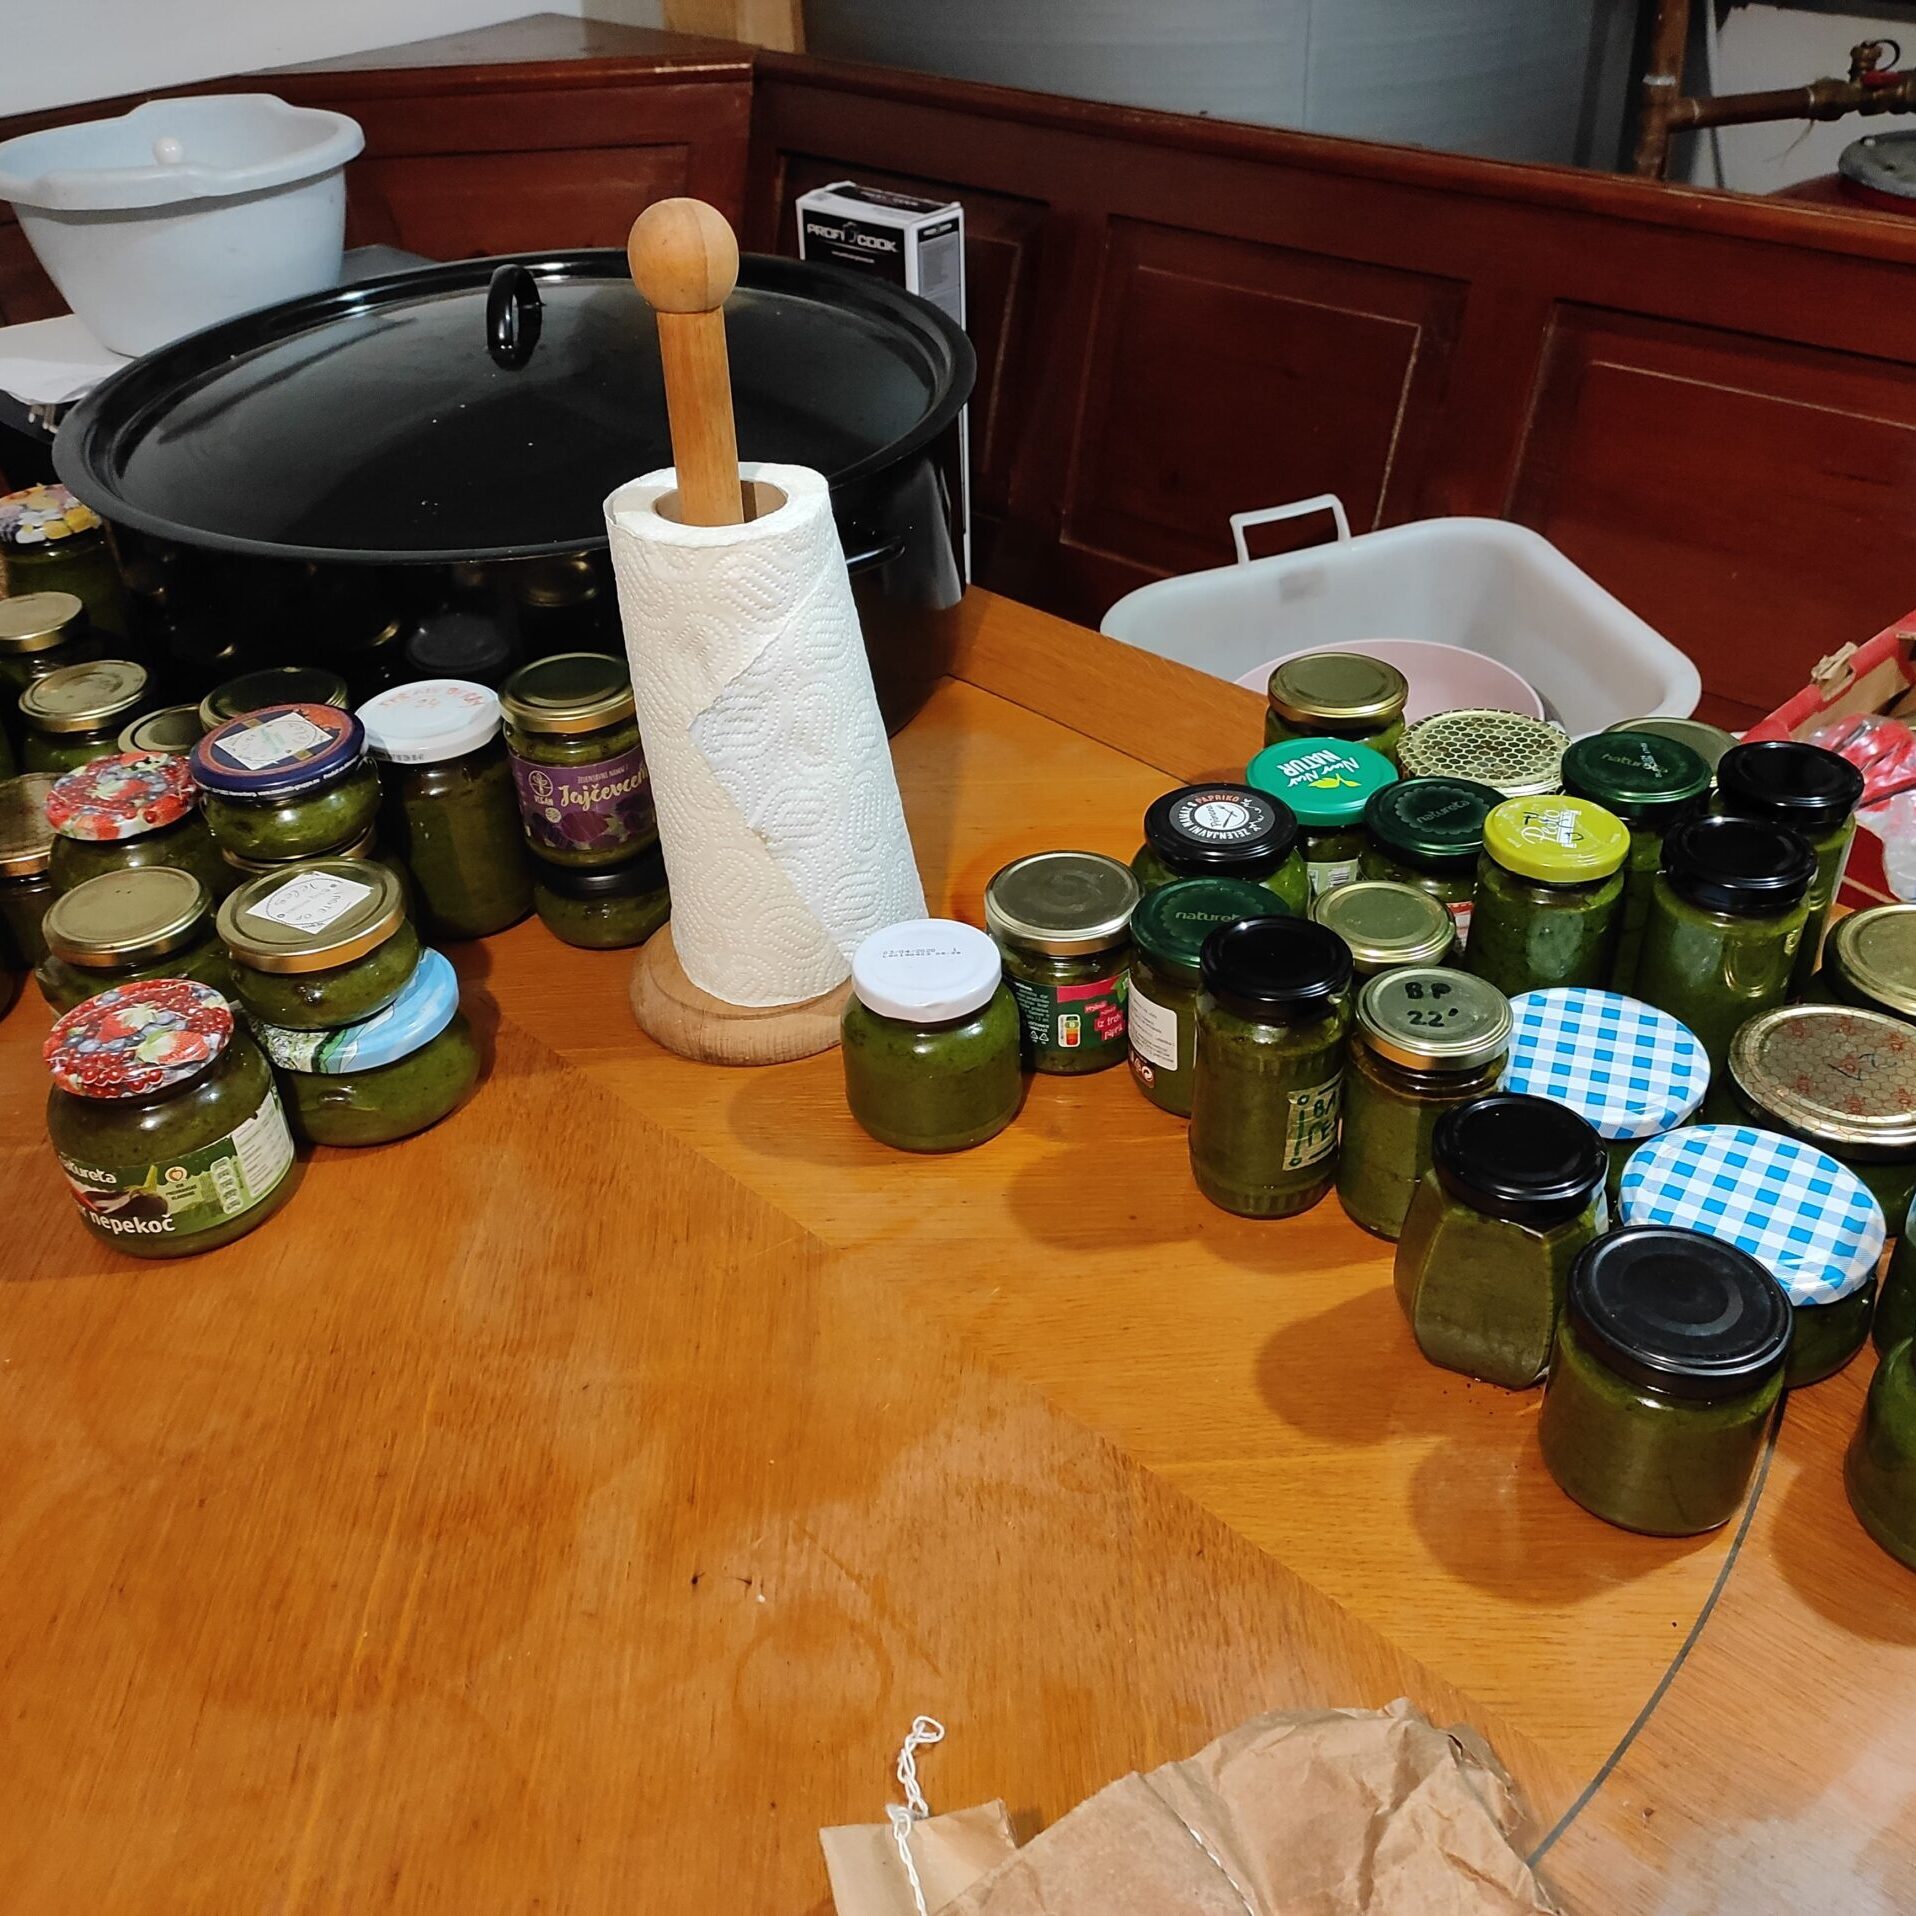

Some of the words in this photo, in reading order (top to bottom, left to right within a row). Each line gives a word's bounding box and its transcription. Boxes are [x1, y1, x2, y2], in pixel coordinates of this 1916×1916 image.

[807, 223, 845, 241] PROFI
[857, 234, 898, 252] COOK
[1277, 750, 1342, 776] NATUR
[1195, 794, 1240, 804] PAPRIKO
[1417, 800, 1470, 823] natureta
[1521, 809, 1563, 845] Pesto
[1175, 911, 1242, 922] naturet
[58, 1156, 117, 1184] tureta
[89, 1211, 176, 1235] nepekoč
